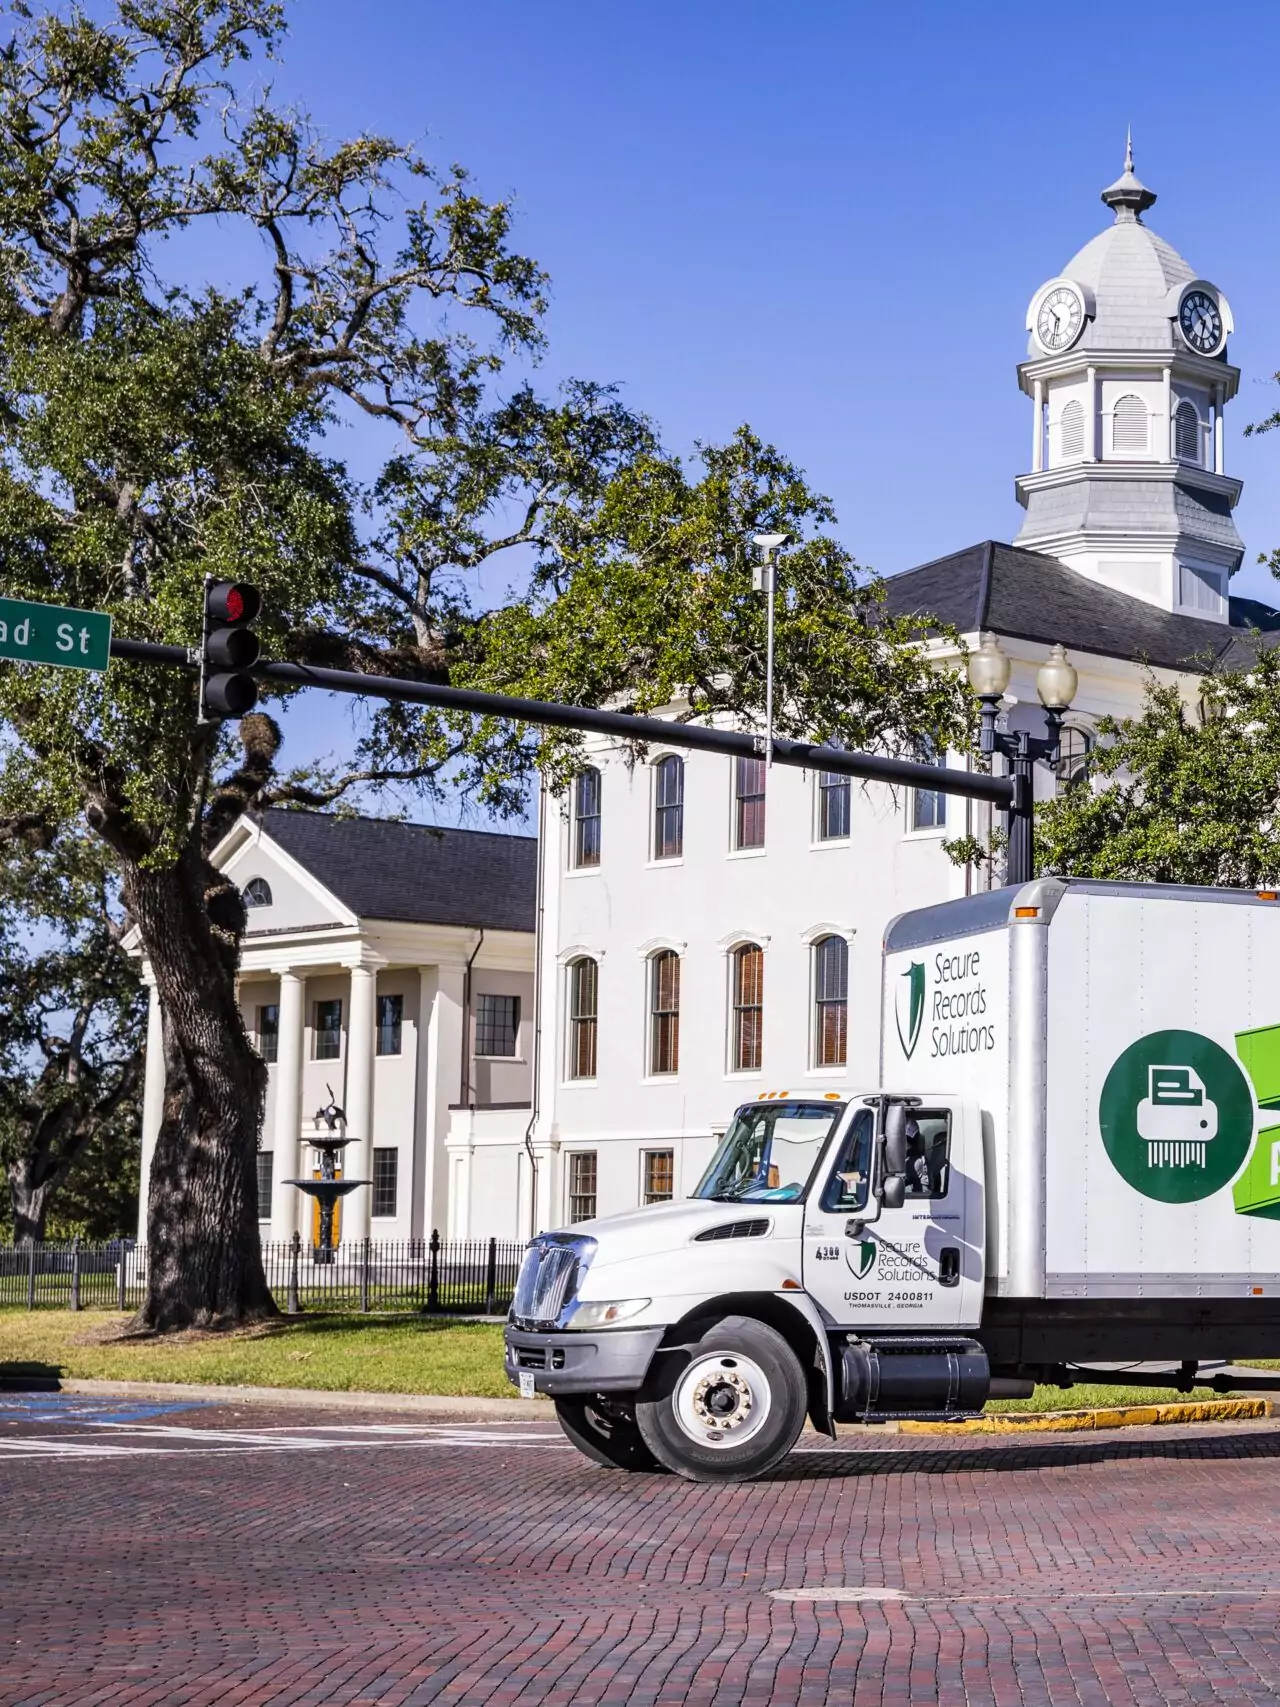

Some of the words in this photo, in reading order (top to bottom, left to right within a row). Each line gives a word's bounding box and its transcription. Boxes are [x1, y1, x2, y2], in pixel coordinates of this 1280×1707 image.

[56, 623, 91, 655] St
[934, 951, 980, 984] Secure
[931, 983, 987, 1021] Records
[931, 1022, 995, 1058] Solutions
[878, 1240, 921, 1253] Secure
[878, 1254, 928, 1267] Records
[877, 1268, 936, 1281] Solutions
[843, 1292, 882, 1301] USDOT
[887, 1292, 934, 1301] 2400811
